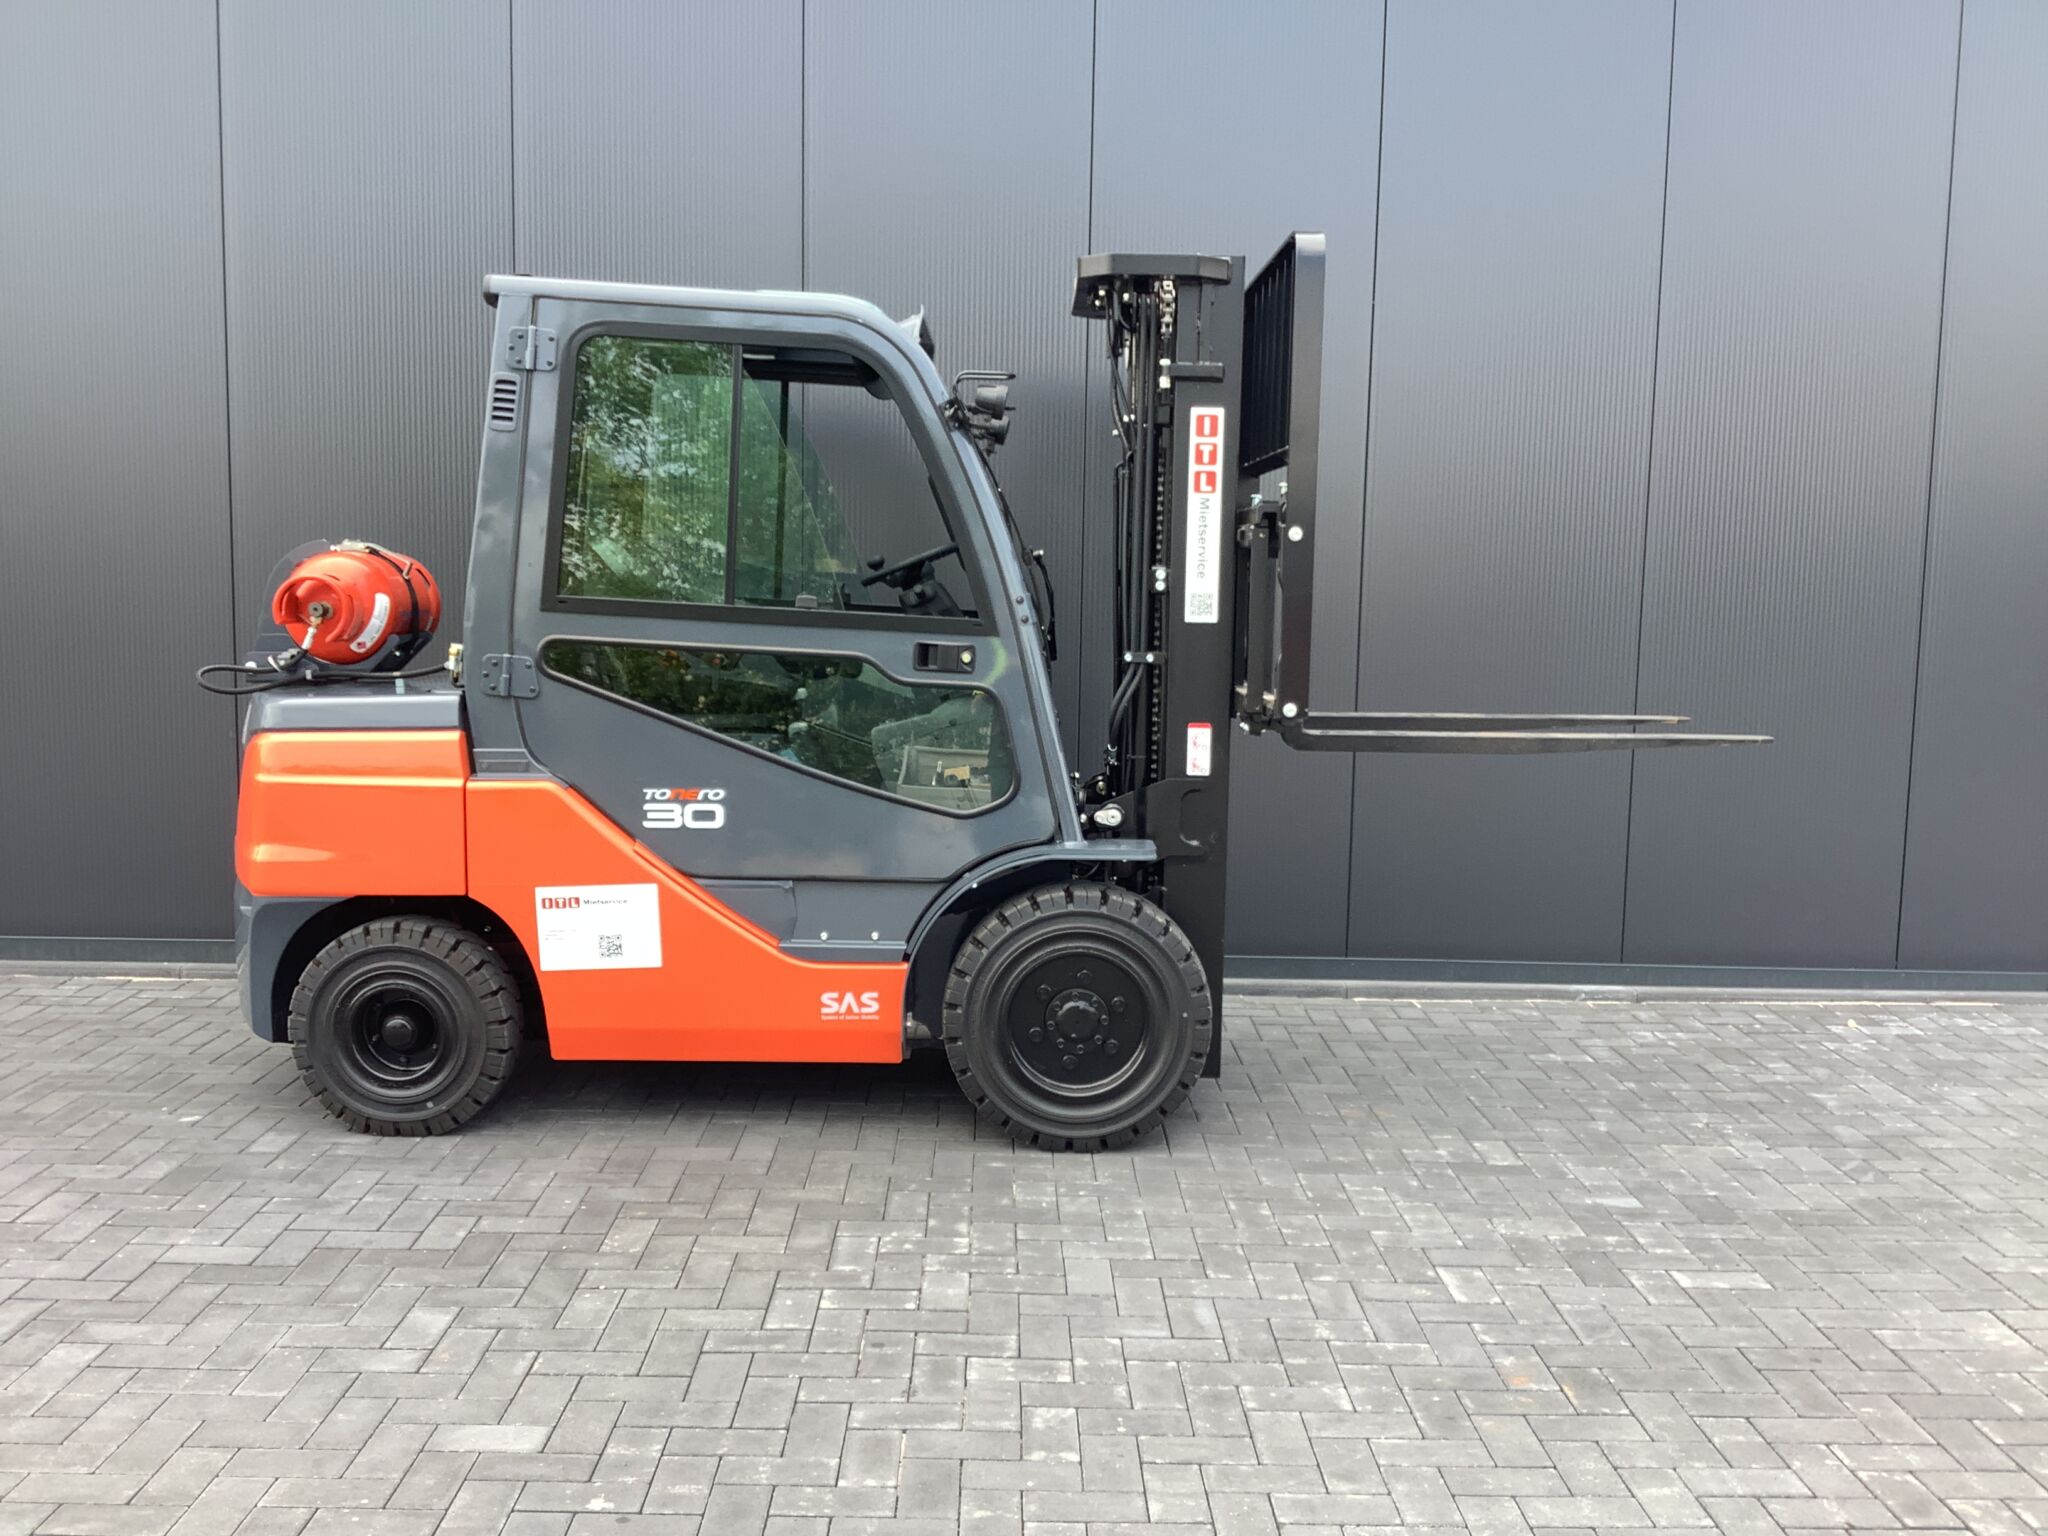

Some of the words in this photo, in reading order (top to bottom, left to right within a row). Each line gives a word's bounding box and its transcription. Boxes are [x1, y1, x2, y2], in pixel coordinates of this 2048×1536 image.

[1195, 415, 1218, 493] ITL
[1197, 497, 1210, 579] Mietservice
[642, 803, 725, 829] 30
[541, 897, 580, 909] ITL
[820, 992, 880, 1014] SAS
